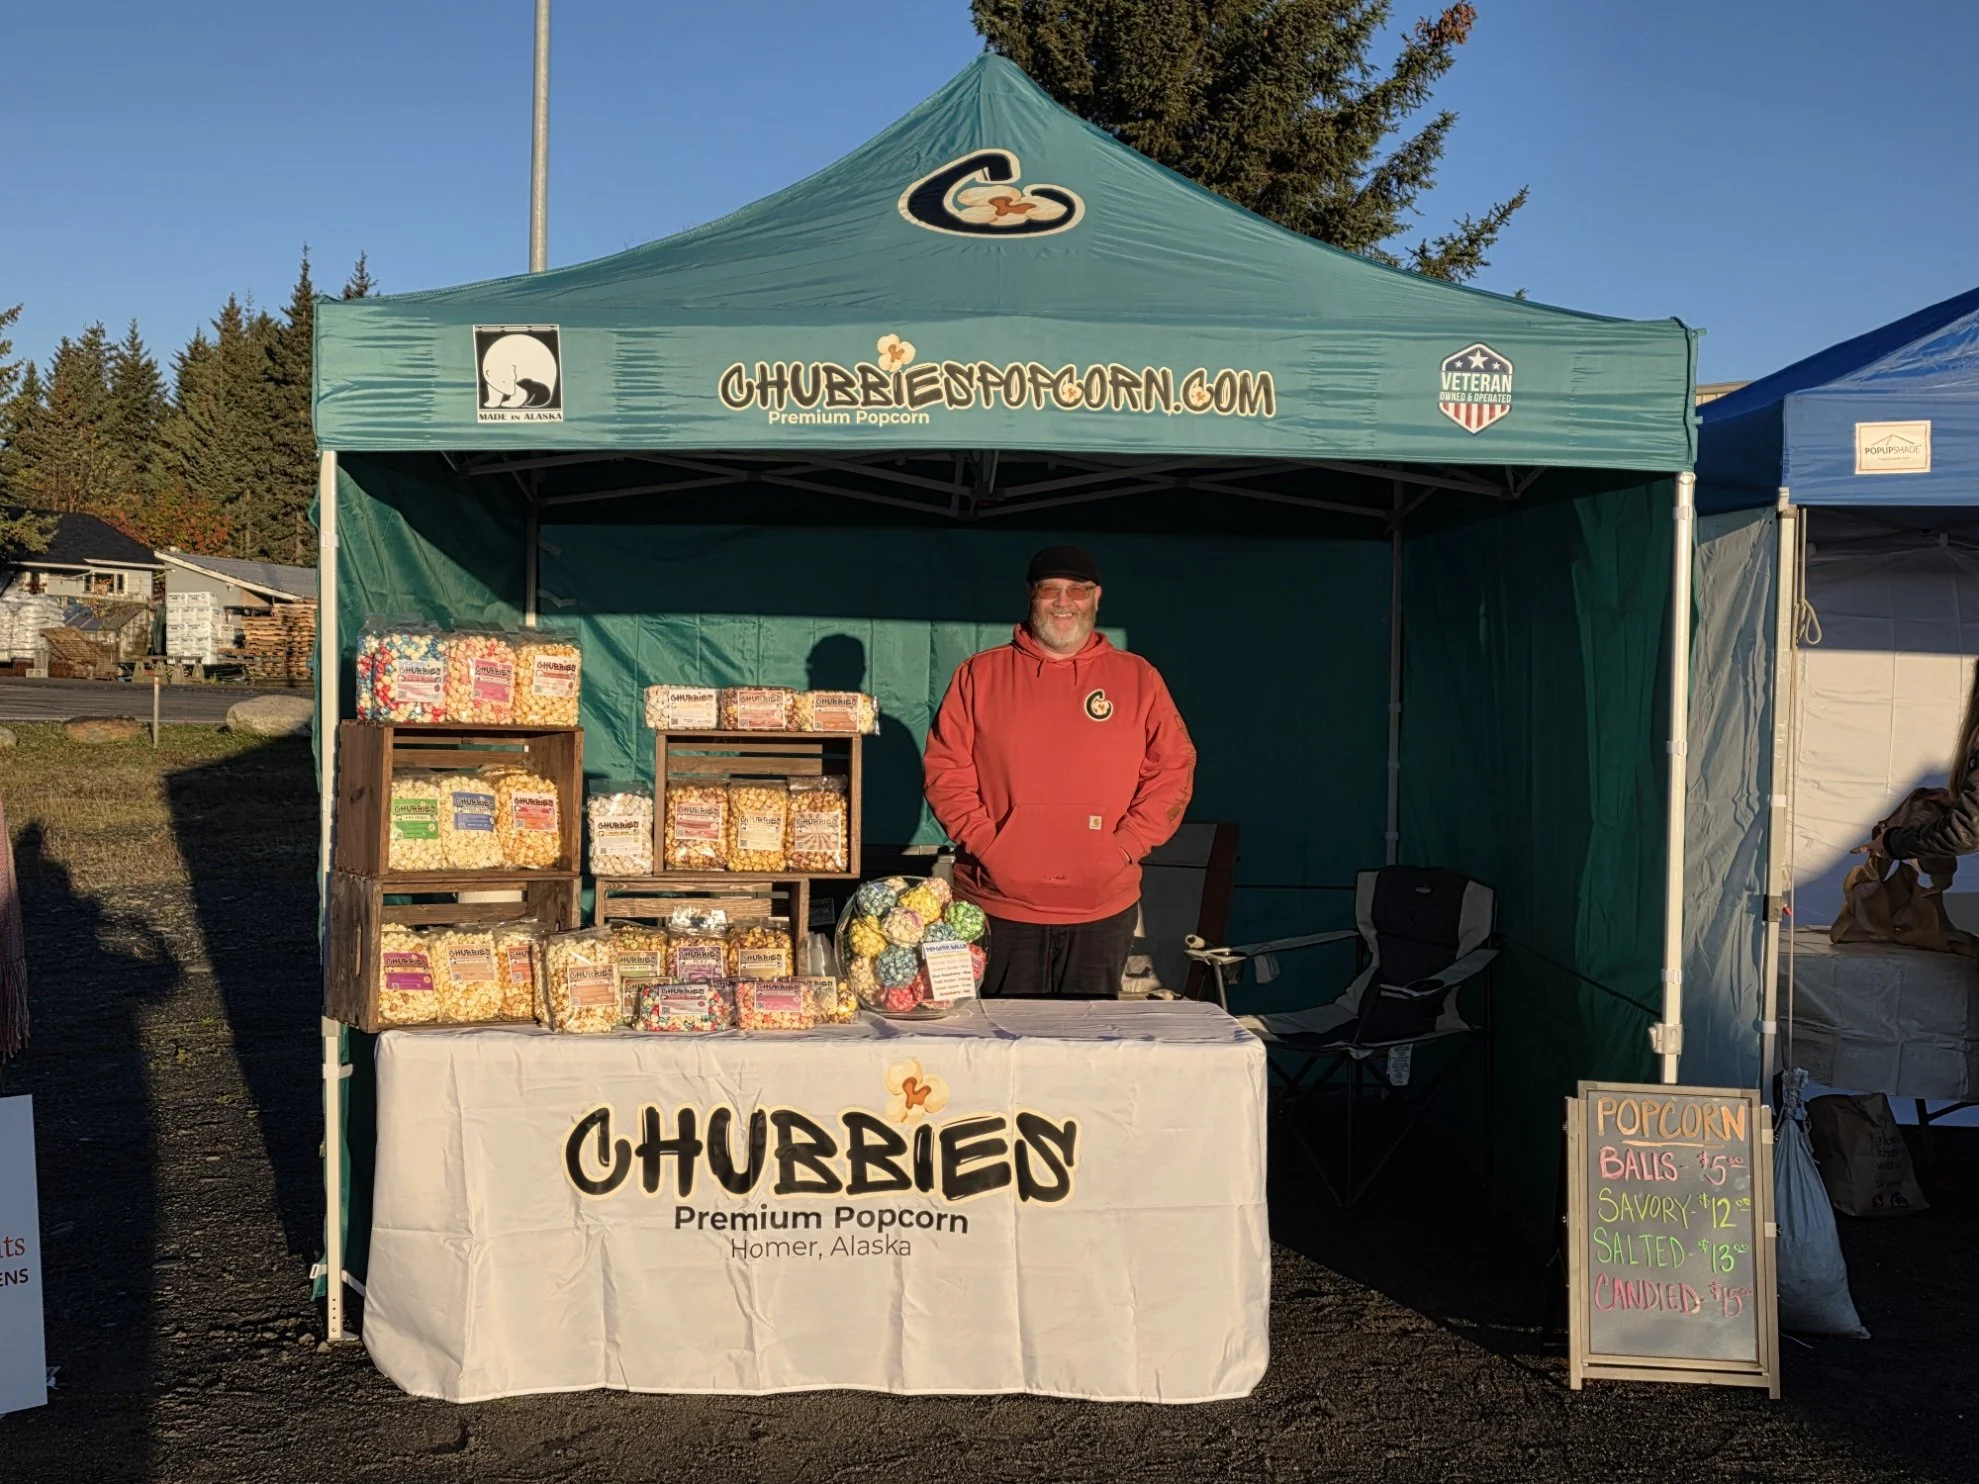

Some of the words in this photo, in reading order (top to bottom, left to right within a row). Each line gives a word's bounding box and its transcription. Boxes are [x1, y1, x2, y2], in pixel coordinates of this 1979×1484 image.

[718, 360, 1277, 418] CHUBBIESPOPCORN.COM
[1441, 372, 1513, 393] VETERAN
[1440, 391, 1466, 402] OWNED
[1467, 392, 1473, 402] &
[1474, 392, 1512, 404] OPERATED
[479, 412, 507, 421] MADE
[524, 412, 562, 420] ALASKA
[768, 409, 850, 425] Premium
[856, 410, 930, 428] Popcorn
[1597, 1095, 1745, 1142] POPCORN
[564, 1103, 1079, 1204] CHUBBIES
[674, 1203, 822, 1231] Premium
[835, 1206, 969, 1234] Popcorn
[731, 1238, 823, 1260] Homer,
[830, 1233, 911, 1257] Alaska
